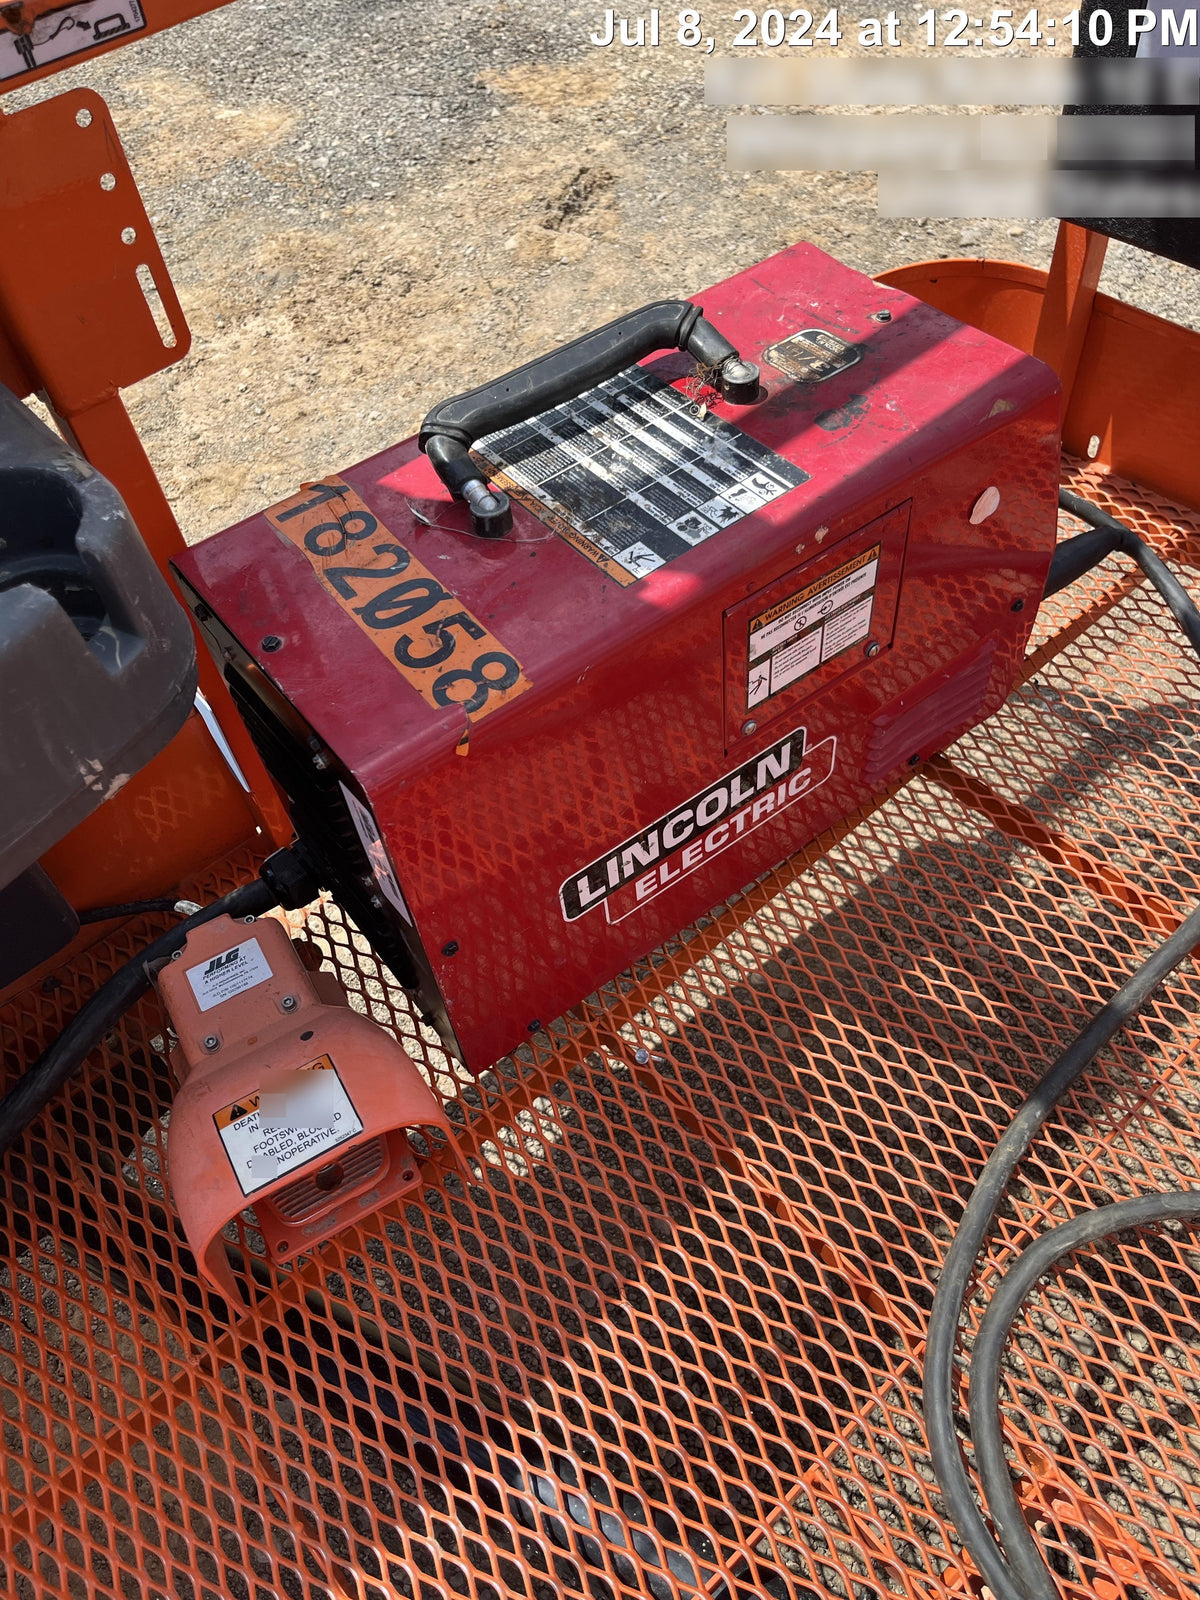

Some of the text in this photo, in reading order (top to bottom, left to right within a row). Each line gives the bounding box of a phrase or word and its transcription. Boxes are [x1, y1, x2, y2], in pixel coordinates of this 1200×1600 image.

[569, 531, 599, 558] WARNING
[275, 484, 520, 713] 182058
[764, 594, 804, 621] WARNING
[807, 555, 866, 596] AVERTISSEMENT
[577, 742, 791, 908] LINCOLN
[635, 767, 812, 901] ELECTRIC
[203, 961, 239, 980] PERFORMING
[239, 955, 247, 965] AT
[204, 948, 240, 976] JLG
[210, 969, 231, 982] HIGHER
[231, 961, 249, 973] LEVEL
[233, 1111, 260, 1132] DEAT
[277, 1127, 340, 1165] NOPERATIVE.
